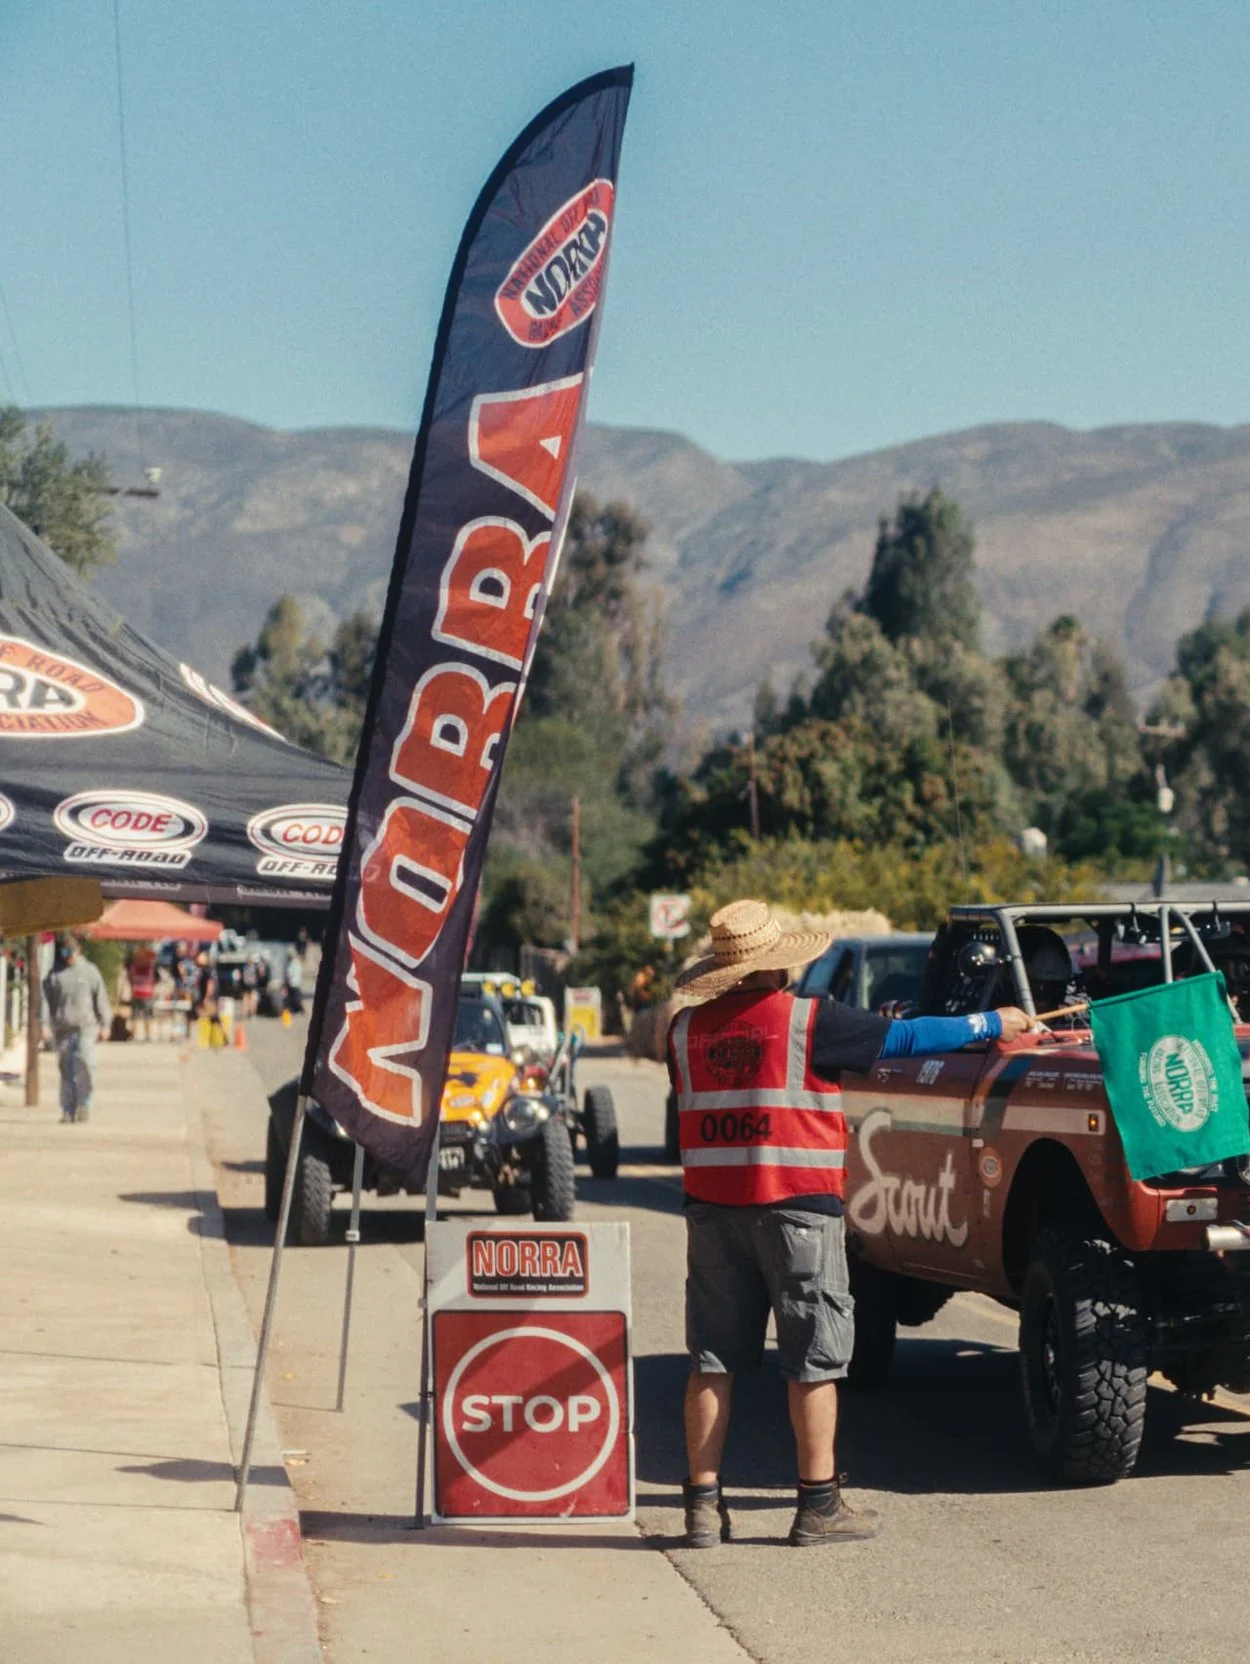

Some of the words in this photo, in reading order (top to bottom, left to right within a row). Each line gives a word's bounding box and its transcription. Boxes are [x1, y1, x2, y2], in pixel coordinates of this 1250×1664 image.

[90, 808, 172, 833] CODE
[282, 824, 345, 845] COD
[701, 1113, 772, 1142] 0064
[848, 1109, 968, 1247] Scout
[472, 1240, 584, 1277] NORRA
[461, 1394, 602, 1433] STOP
